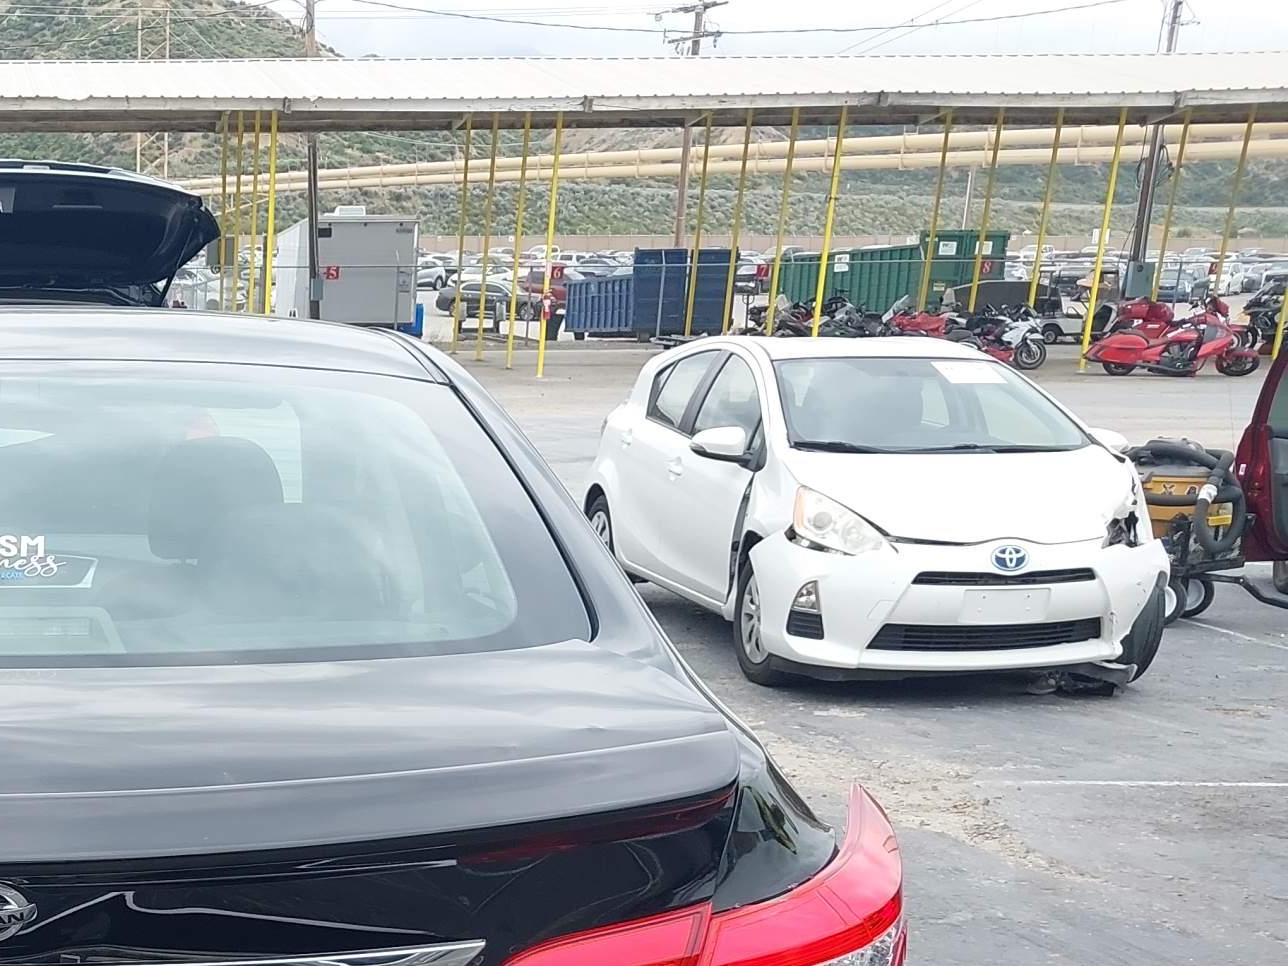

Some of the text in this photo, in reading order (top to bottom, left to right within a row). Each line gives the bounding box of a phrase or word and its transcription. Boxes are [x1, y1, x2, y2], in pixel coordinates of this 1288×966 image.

[328, 266, 337, 279] 5
[553, 267, 561, 279] 6
[982, 261, 992, 273] 8
